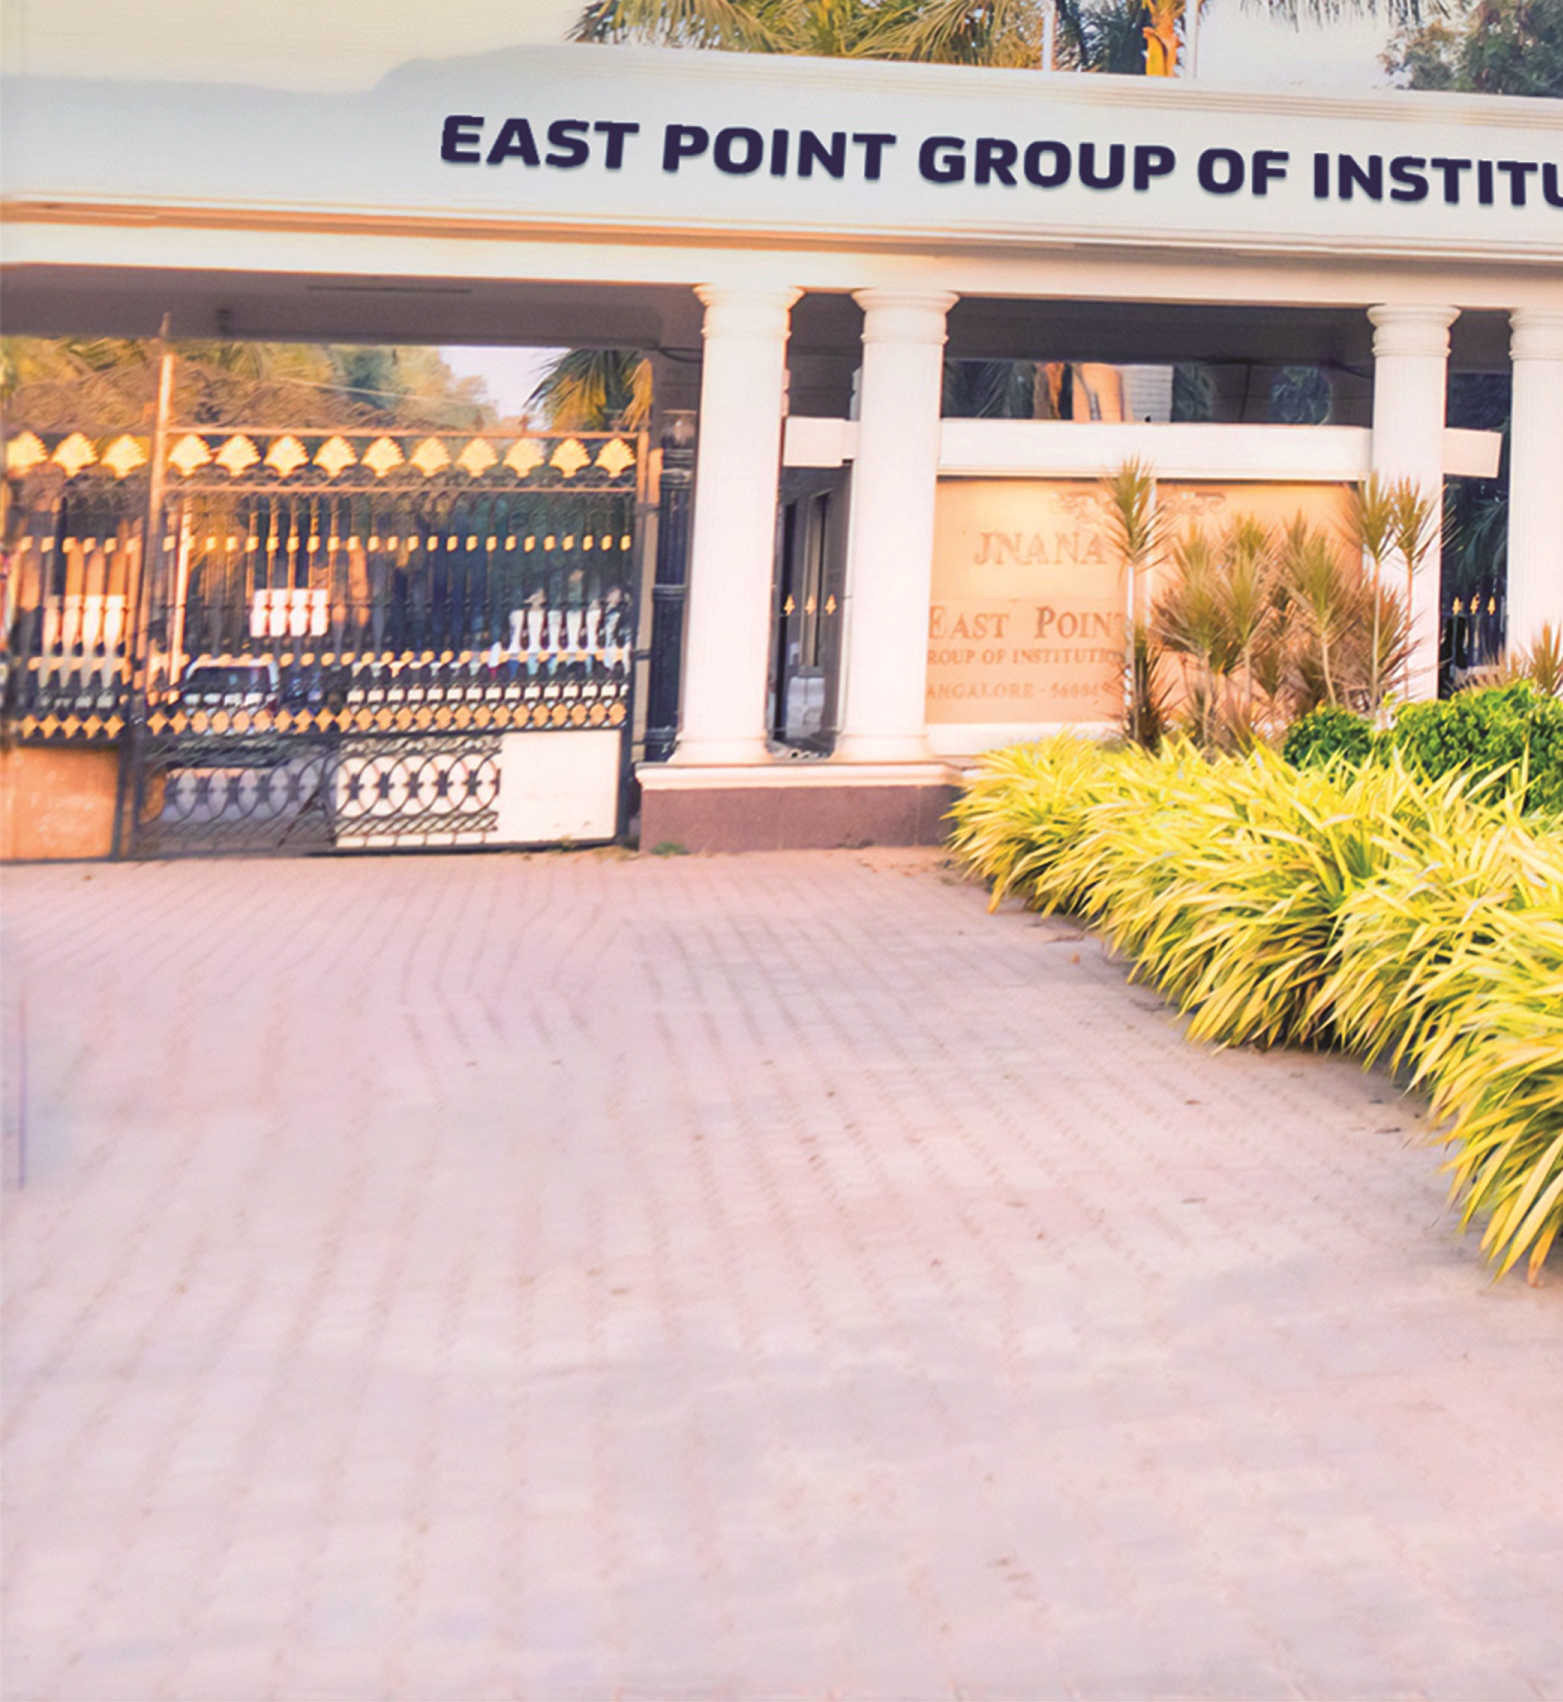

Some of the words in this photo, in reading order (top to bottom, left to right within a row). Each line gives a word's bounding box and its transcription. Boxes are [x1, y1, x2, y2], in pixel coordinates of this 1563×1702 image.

[440, 114, 640, 171] EAST
[662, 123, 897, 181] POINT
[918, 136, 1176, 192] GROUP
[1197, 147, 1290, 197] OF
[973, 532, 1108, 565] JNANA
[929, 605, 1009, 639] EAST
[927, 650, 975, 666] ROUP
[982, 649, 1004, 665] OF
[926, 683, 1034, 699] ANGALORE
